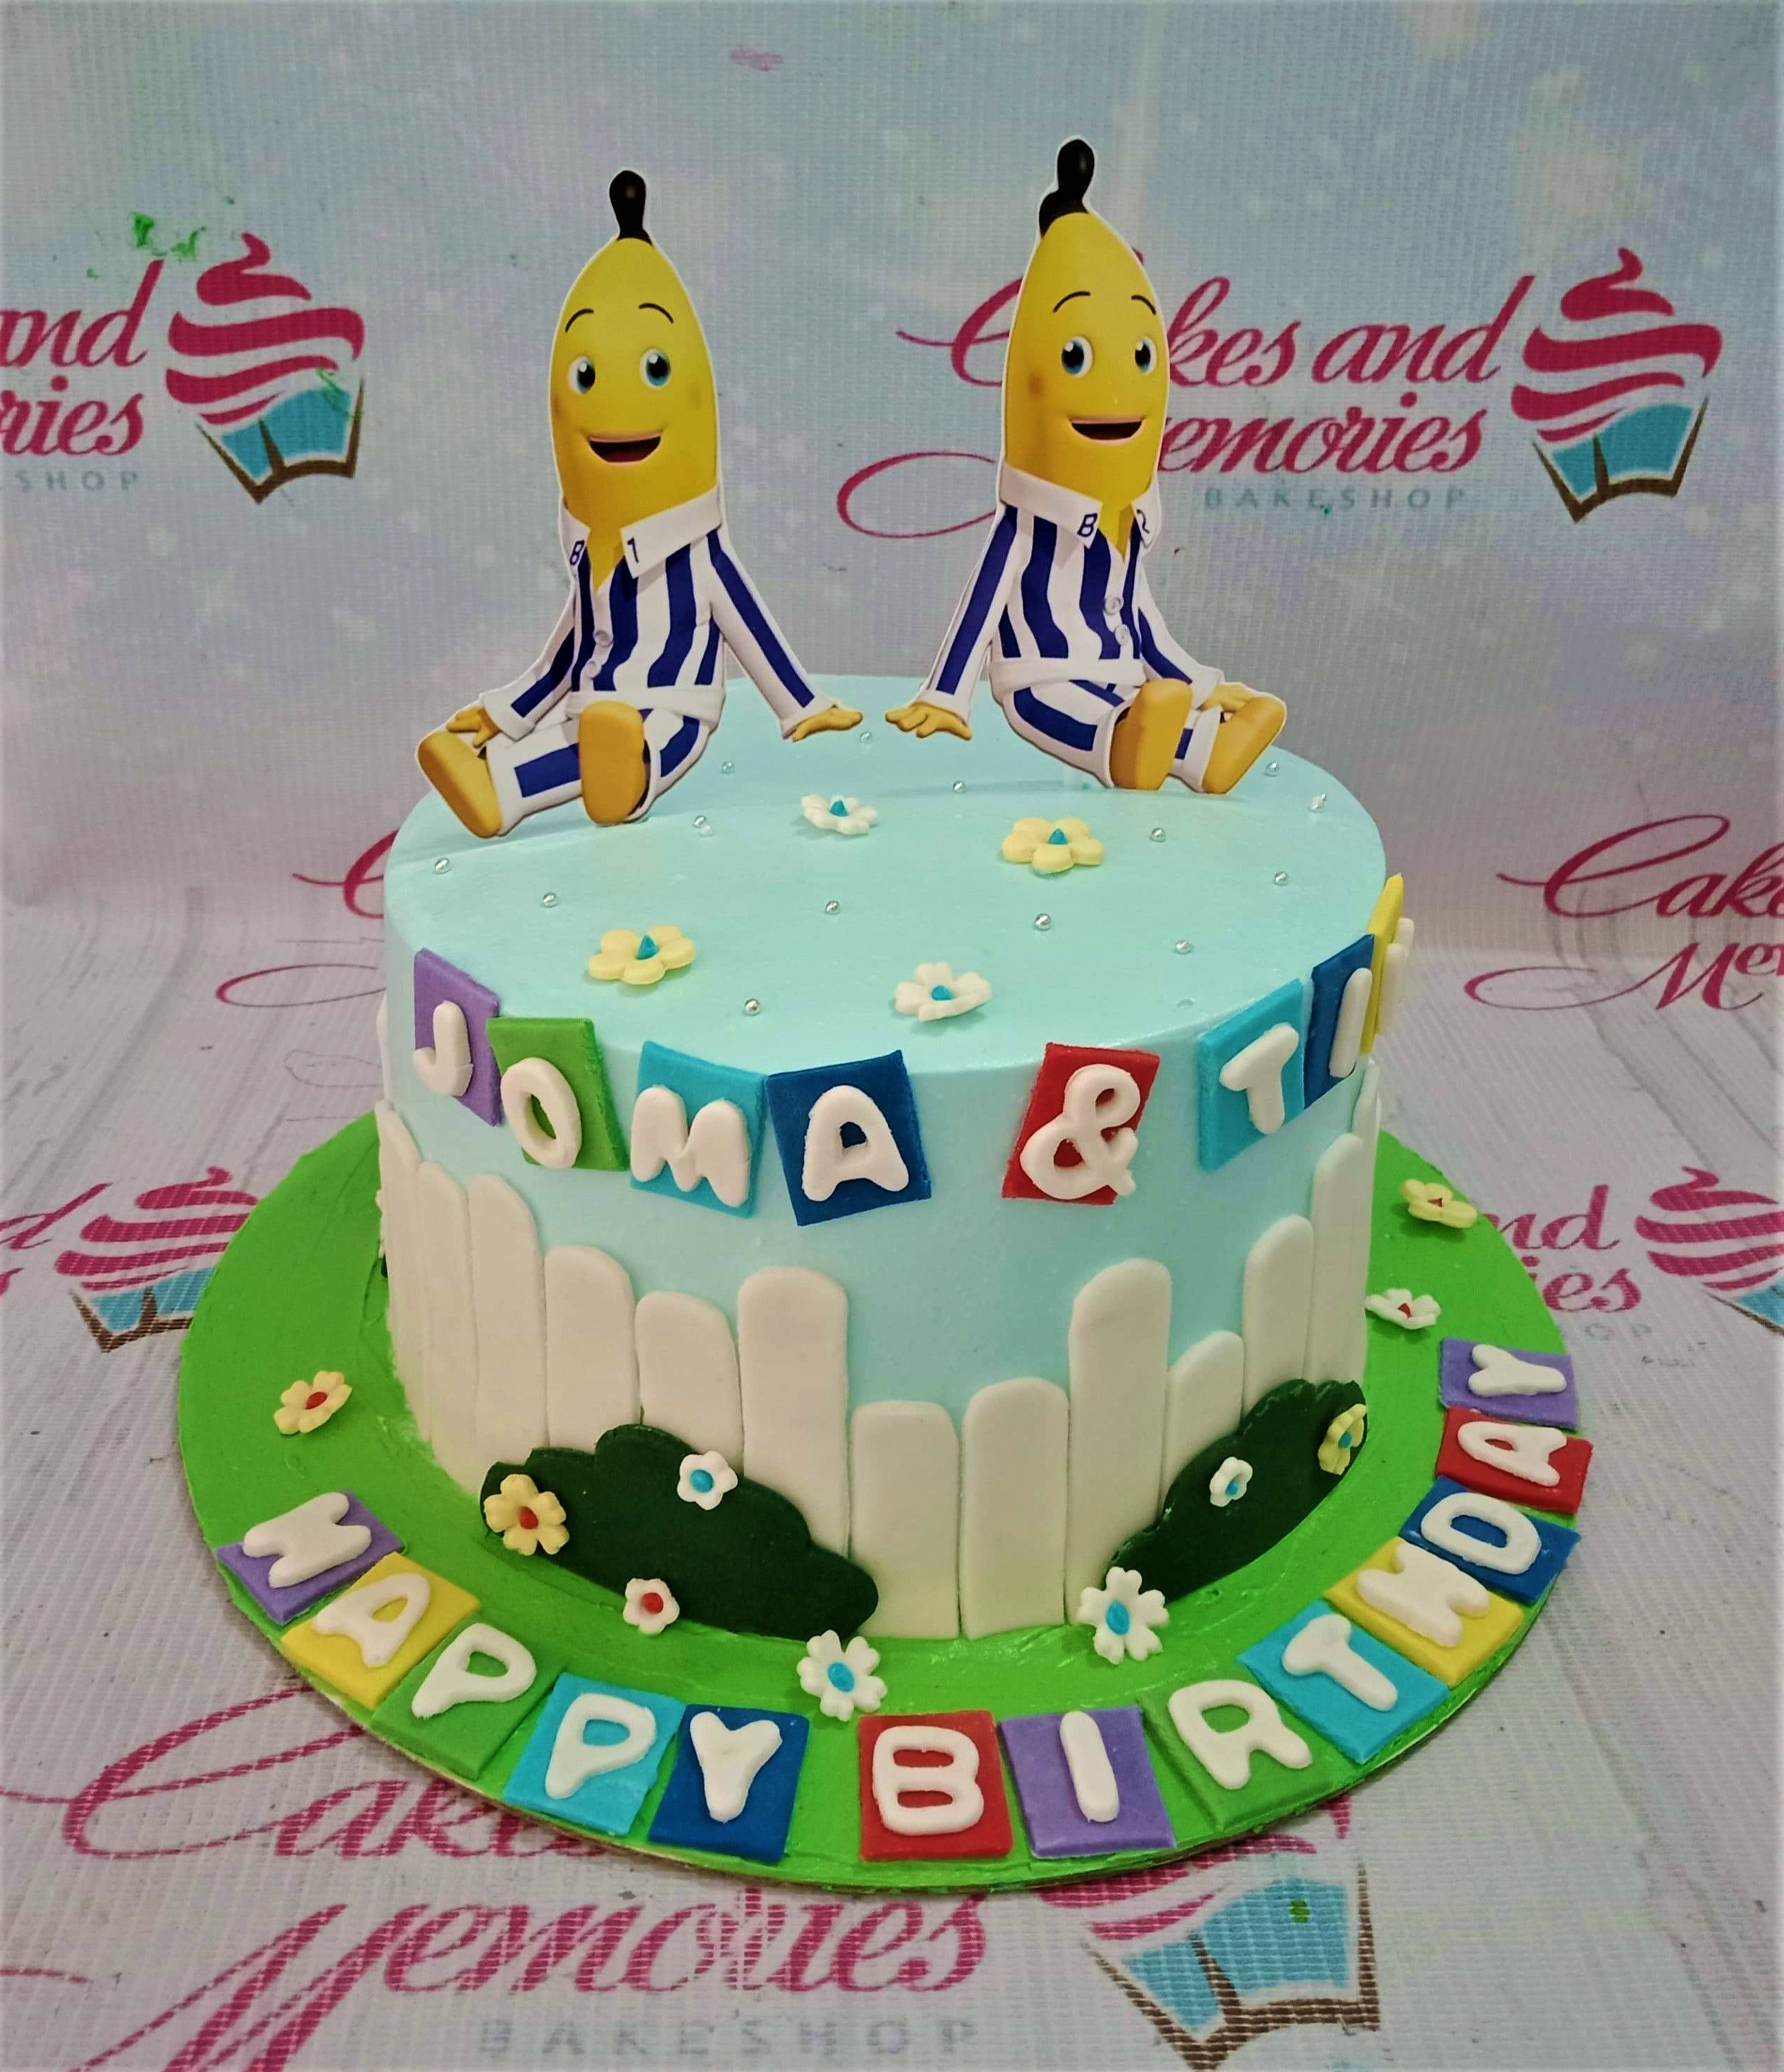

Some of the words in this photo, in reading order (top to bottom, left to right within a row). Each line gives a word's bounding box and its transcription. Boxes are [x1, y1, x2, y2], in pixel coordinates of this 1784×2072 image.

[0, 258, 165, 367] nd
[1311, 273, 1536, 384] and
[0, 375, 145, 456] ries
[1203, 488, 1466, 509] BAKESHOP
[1496, 814, 1784, 919] Cak
[413, 1000, 910, 1209] JOMA
[1019, 1063, 1144, 1200] &
[242, 1490, 782, 1824] HAPPY
[872, 1343, 1568, 1836] BIRTHDAY
[478, 2019, 980, 2057] BAKESHOP
